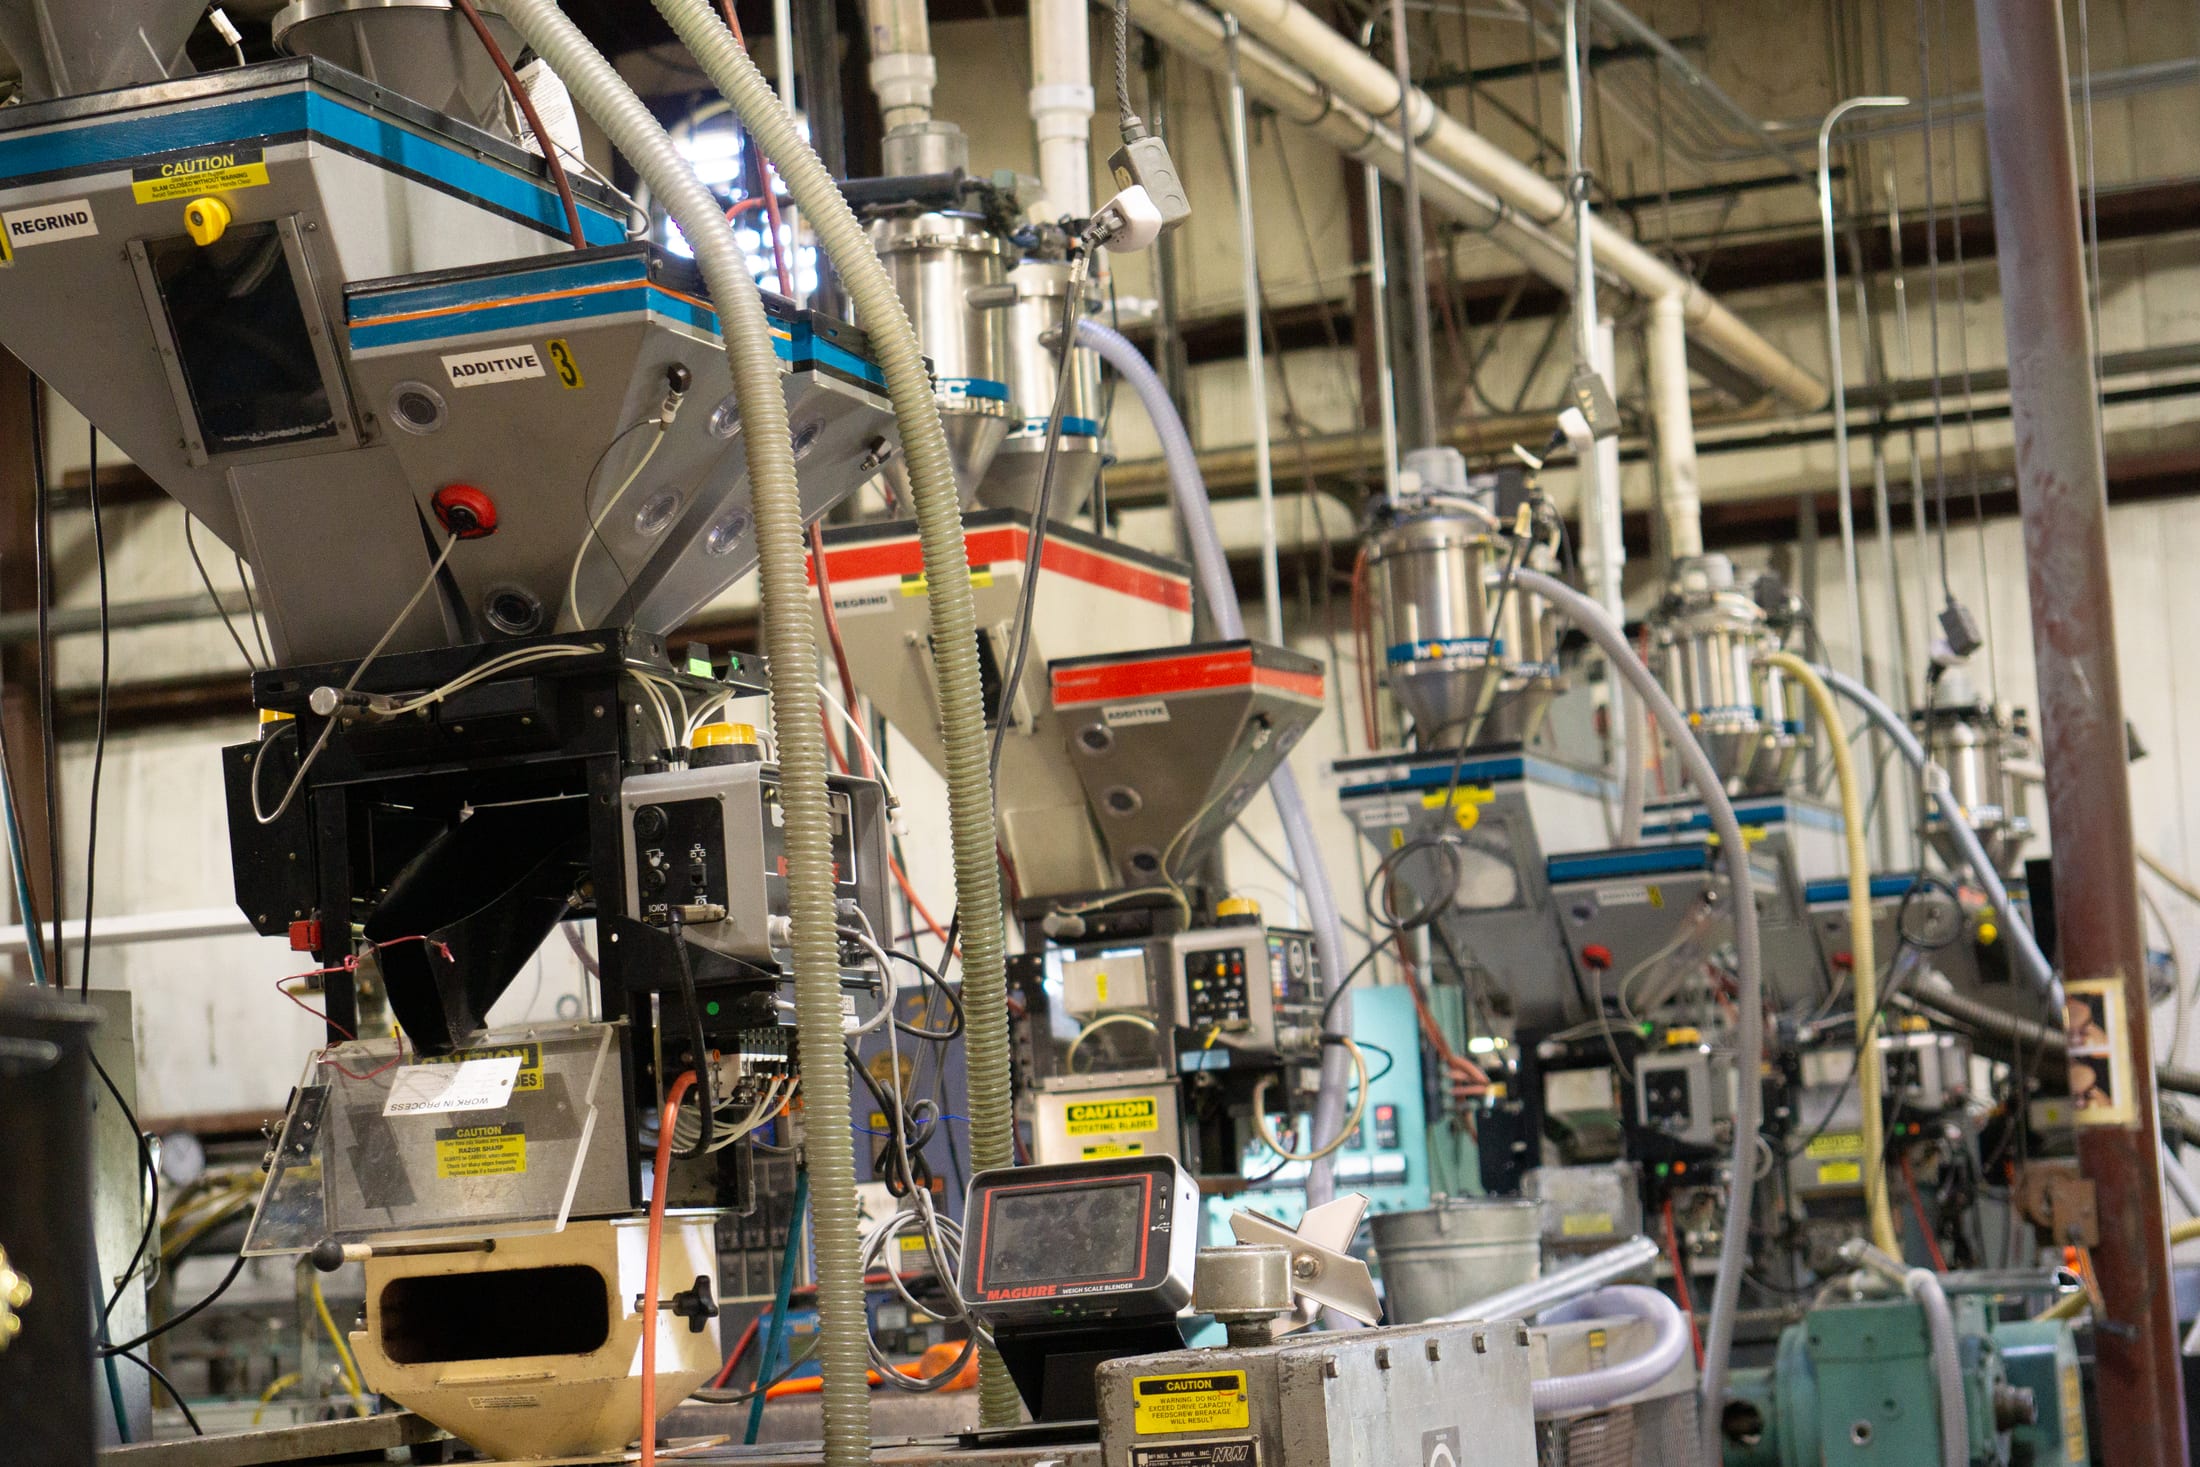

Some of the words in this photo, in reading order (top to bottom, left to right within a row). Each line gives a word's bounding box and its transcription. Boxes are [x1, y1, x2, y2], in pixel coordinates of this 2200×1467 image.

[161, 154, 235, 177] CAUTION
[11, 211, 89, 235] REGRIND
[452, 355, 538, 378] ADDITIVE
[551, 342, 577, 386] 3
[834, 595, 888, 609] REGRIND
[390, 1101, 441, 1111] PROCESS
[443, 1099, 454, 1107] IN
[457, 1097, 488, 1107] WORK
[1071, 1102, 1149, 1120] CAUTION
[456, 1126, 502, 1138] CAUTION
[986, 1285, 1058, 1300] MAGUIRE
[1084, 1285, 1103, 1293] SCALE
[1104, 1283, 1133, 1291] BLENDER
[1166, 1379, 1212, 1391] CAUTION
[1152, 1411, 1193, 1419] FEEDSCREW
[1188, 1416, 1214, 1424] RESULT
[1212, 1445, 1249, 1462] NRM
